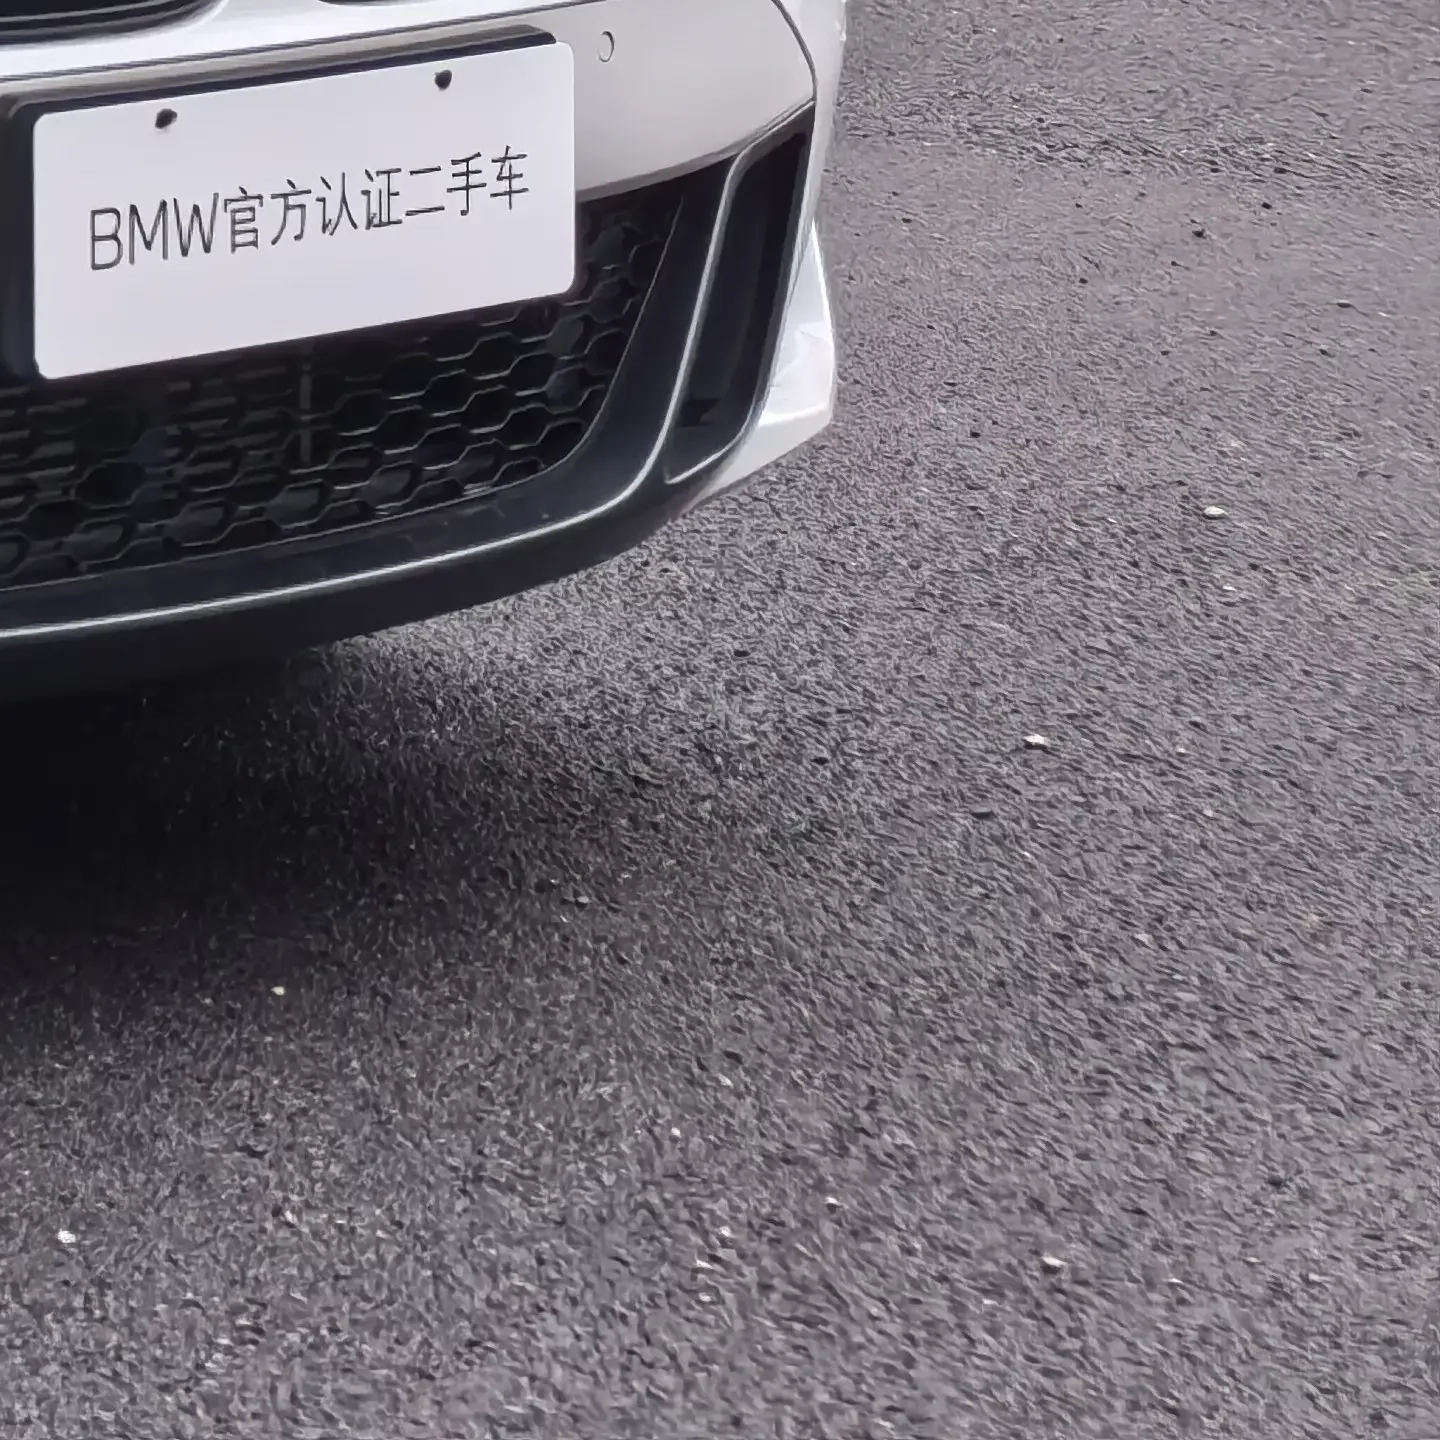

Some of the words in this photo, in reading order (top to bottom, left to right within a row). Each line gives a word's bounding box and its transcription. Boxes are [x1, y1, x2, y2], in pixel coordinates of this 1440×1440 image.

[89, 145, 530, 272] BMW官方认证二手车
